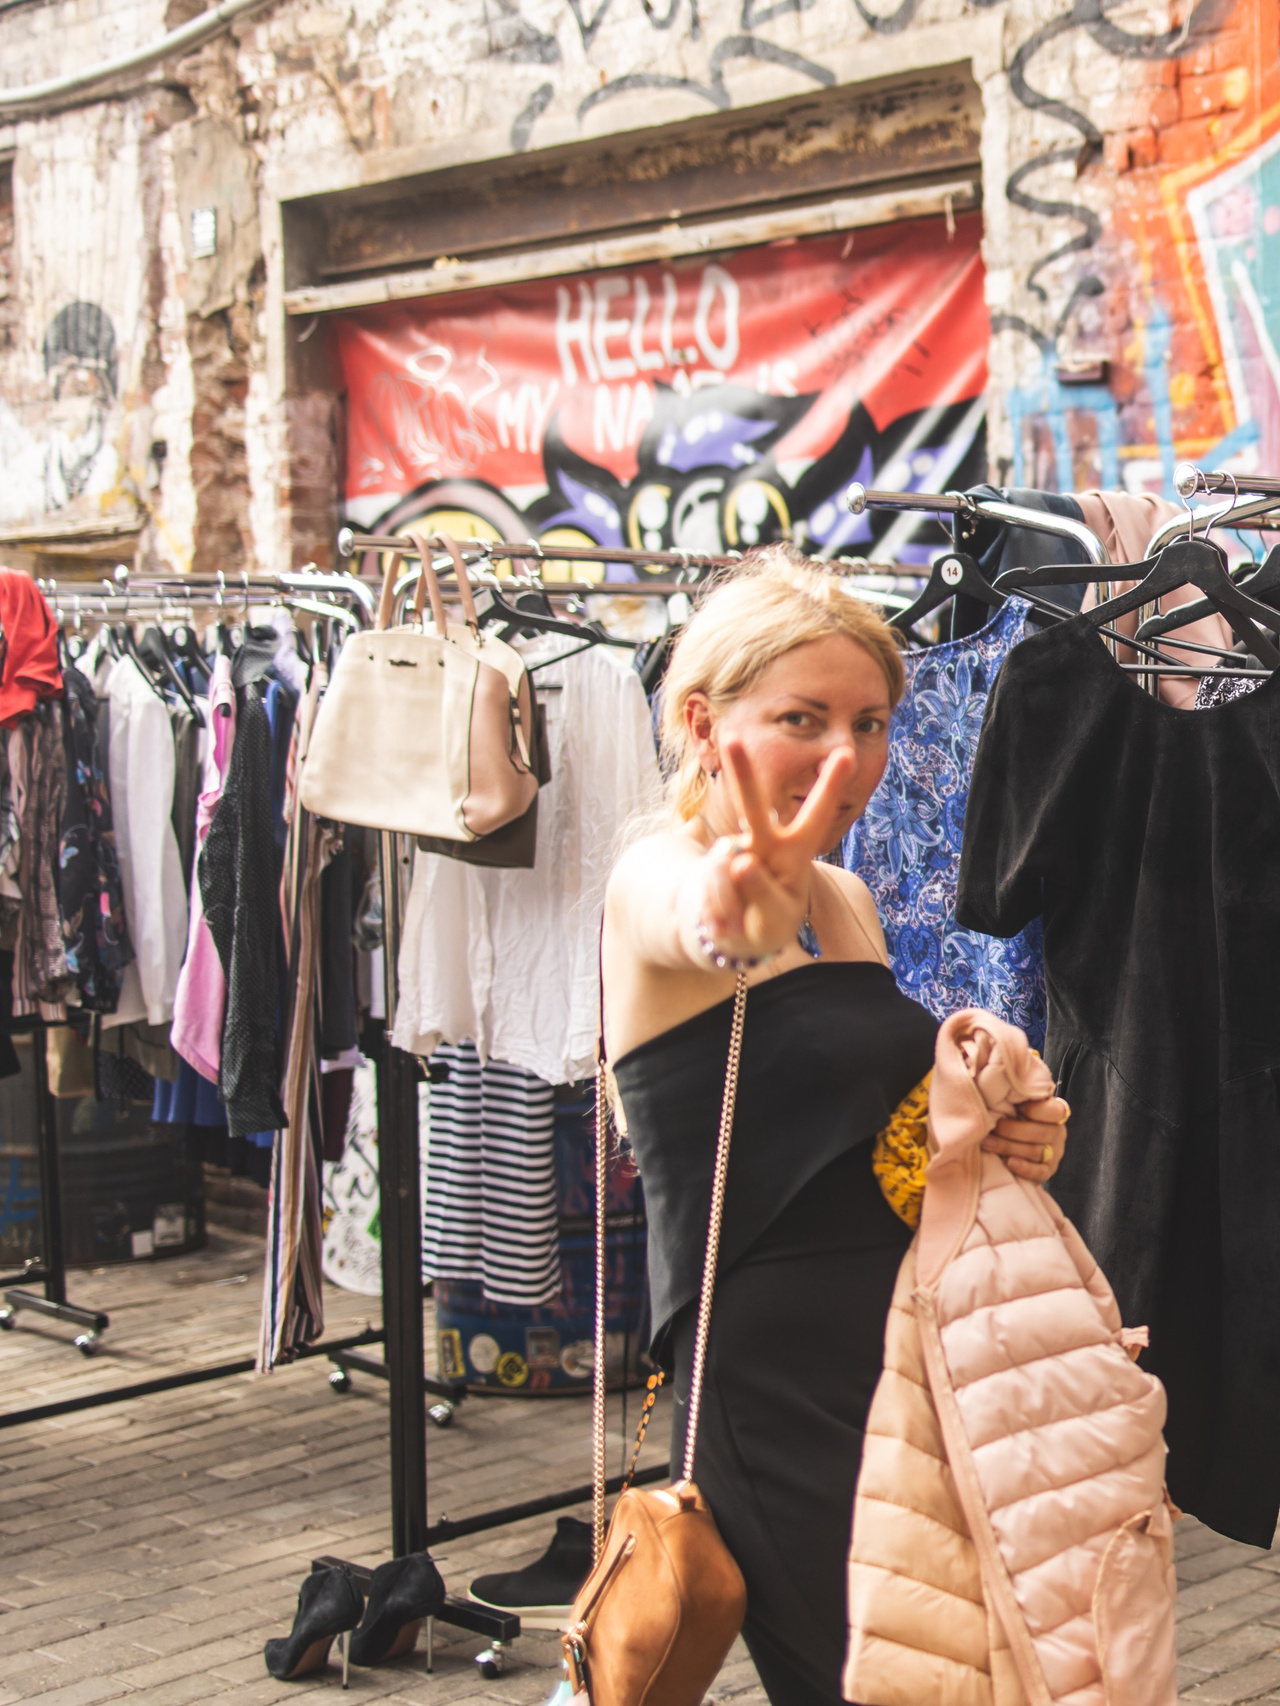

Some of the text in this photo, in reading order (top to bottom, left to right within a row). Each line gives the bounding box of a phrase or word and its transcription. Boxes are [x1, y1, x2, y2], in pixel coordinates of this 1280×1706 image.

[556, 265, 740, 387] HELLO
[497, 378, 560, 454] MY
[946, 567, 958, 577] 14
